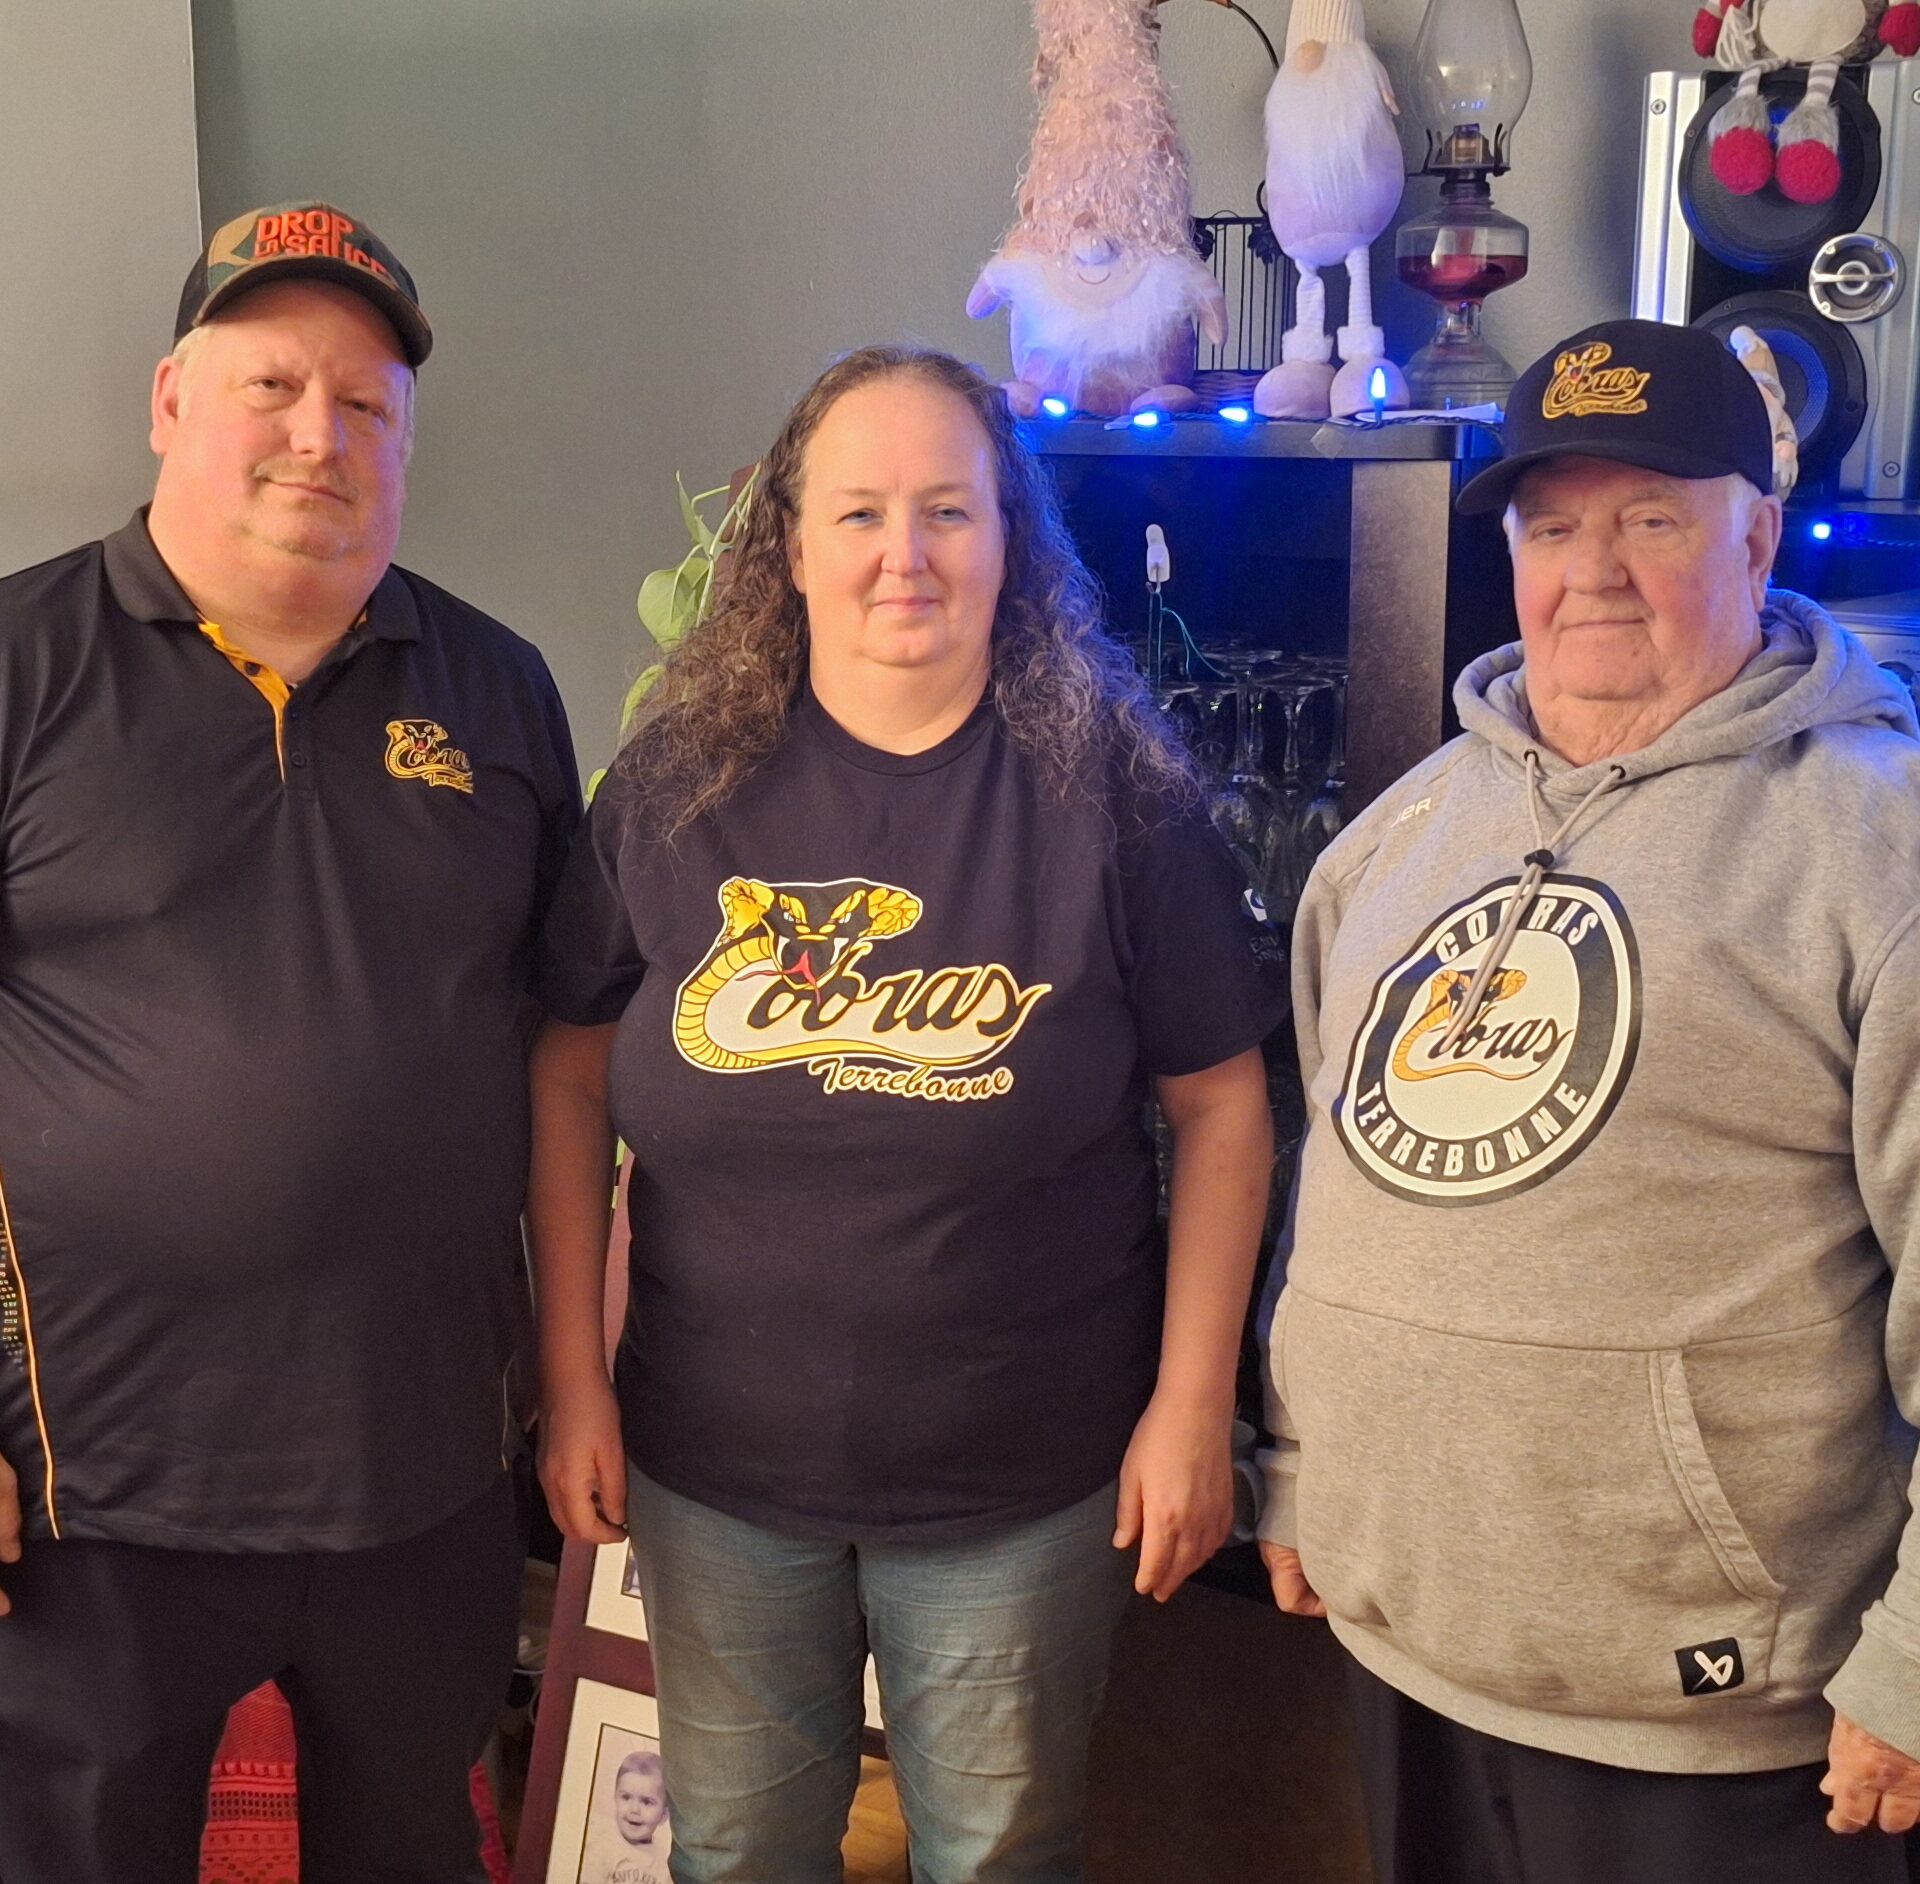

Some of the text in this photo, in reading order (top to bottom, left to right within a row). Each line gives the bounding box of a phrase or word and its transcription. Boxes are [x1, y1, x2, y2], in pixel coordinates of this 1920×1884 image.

[254, 239, 279, 258] LA
[257, 210, 354, 248] DROP
[674, 932, 1052, 1072] Cobras
[807, 1056, 1014, 1101] Terrebonne
[1356, 1081, 1588, 1177] TERREBONNE
